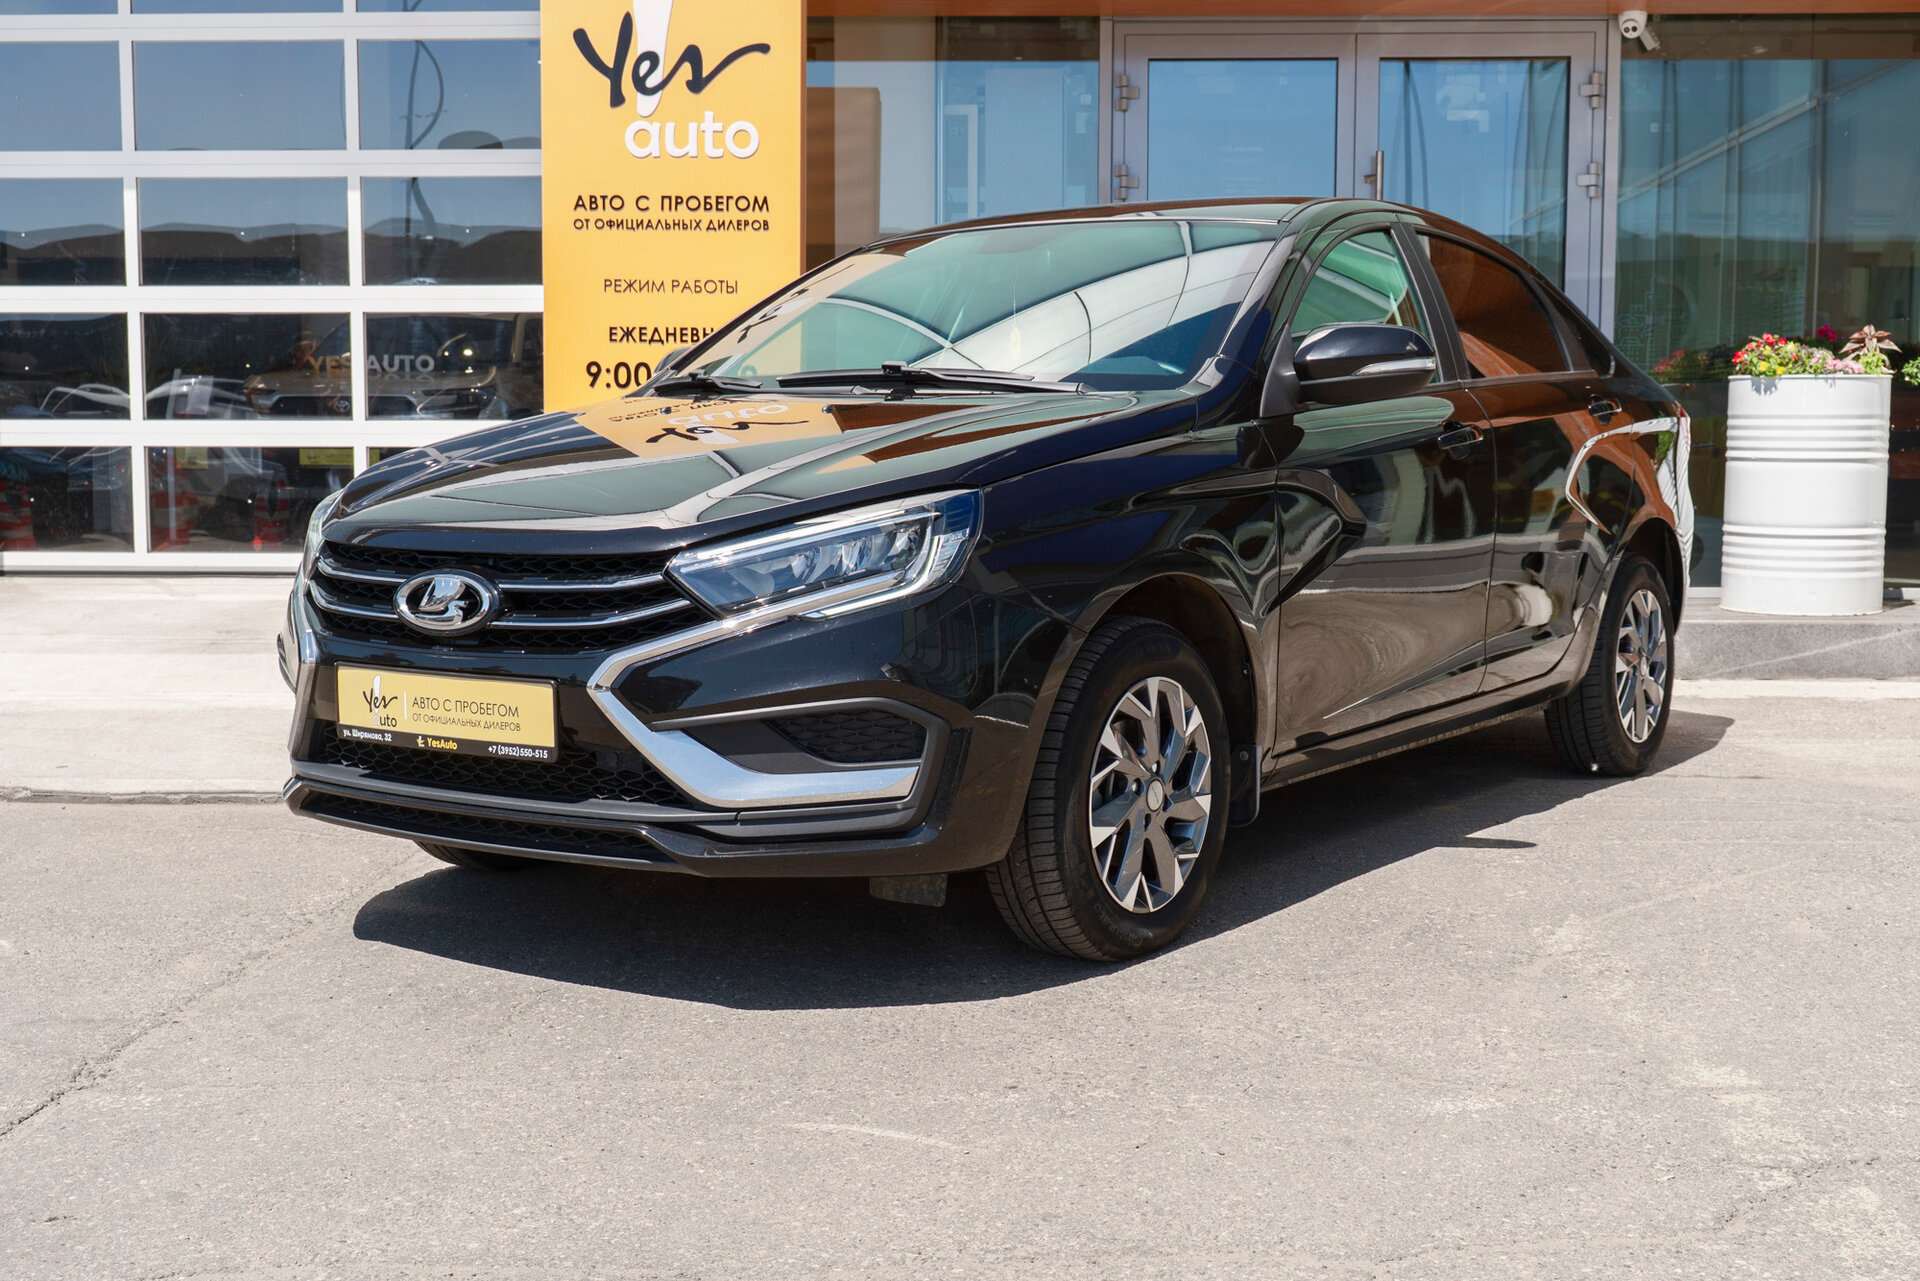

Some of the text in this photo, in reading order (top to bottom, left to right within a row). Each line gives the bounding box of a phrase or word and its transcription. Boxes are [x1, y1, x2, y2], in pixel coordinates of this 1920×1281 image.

[624, 110, 760, 159] auto
[573, 194, 770, 213] АВТО С ПРОБЕГОМ
[573, 218, 770, 233] ОТ ОФИЦИАЛЬНЫХ ДИЛЕРОВ
[603, 278, 738, 295] РЕЖИМ РАБОТЫ
[608, 326, 715, 346] ЕЖЕДНЕВН
[367, 354, 435, 373] AUTO
[585, 360, 651, 389] 9:00
[411, 696, 519, 718] АВТО С ПРОБЕГОМ
[412, 712, 521, 732] ОТ ОФИЦИАЛЬНЫХ ДИЛЕРОВ
[384, 732, 392, 741] 32
[427, 737, 458, 750] YesAuto
